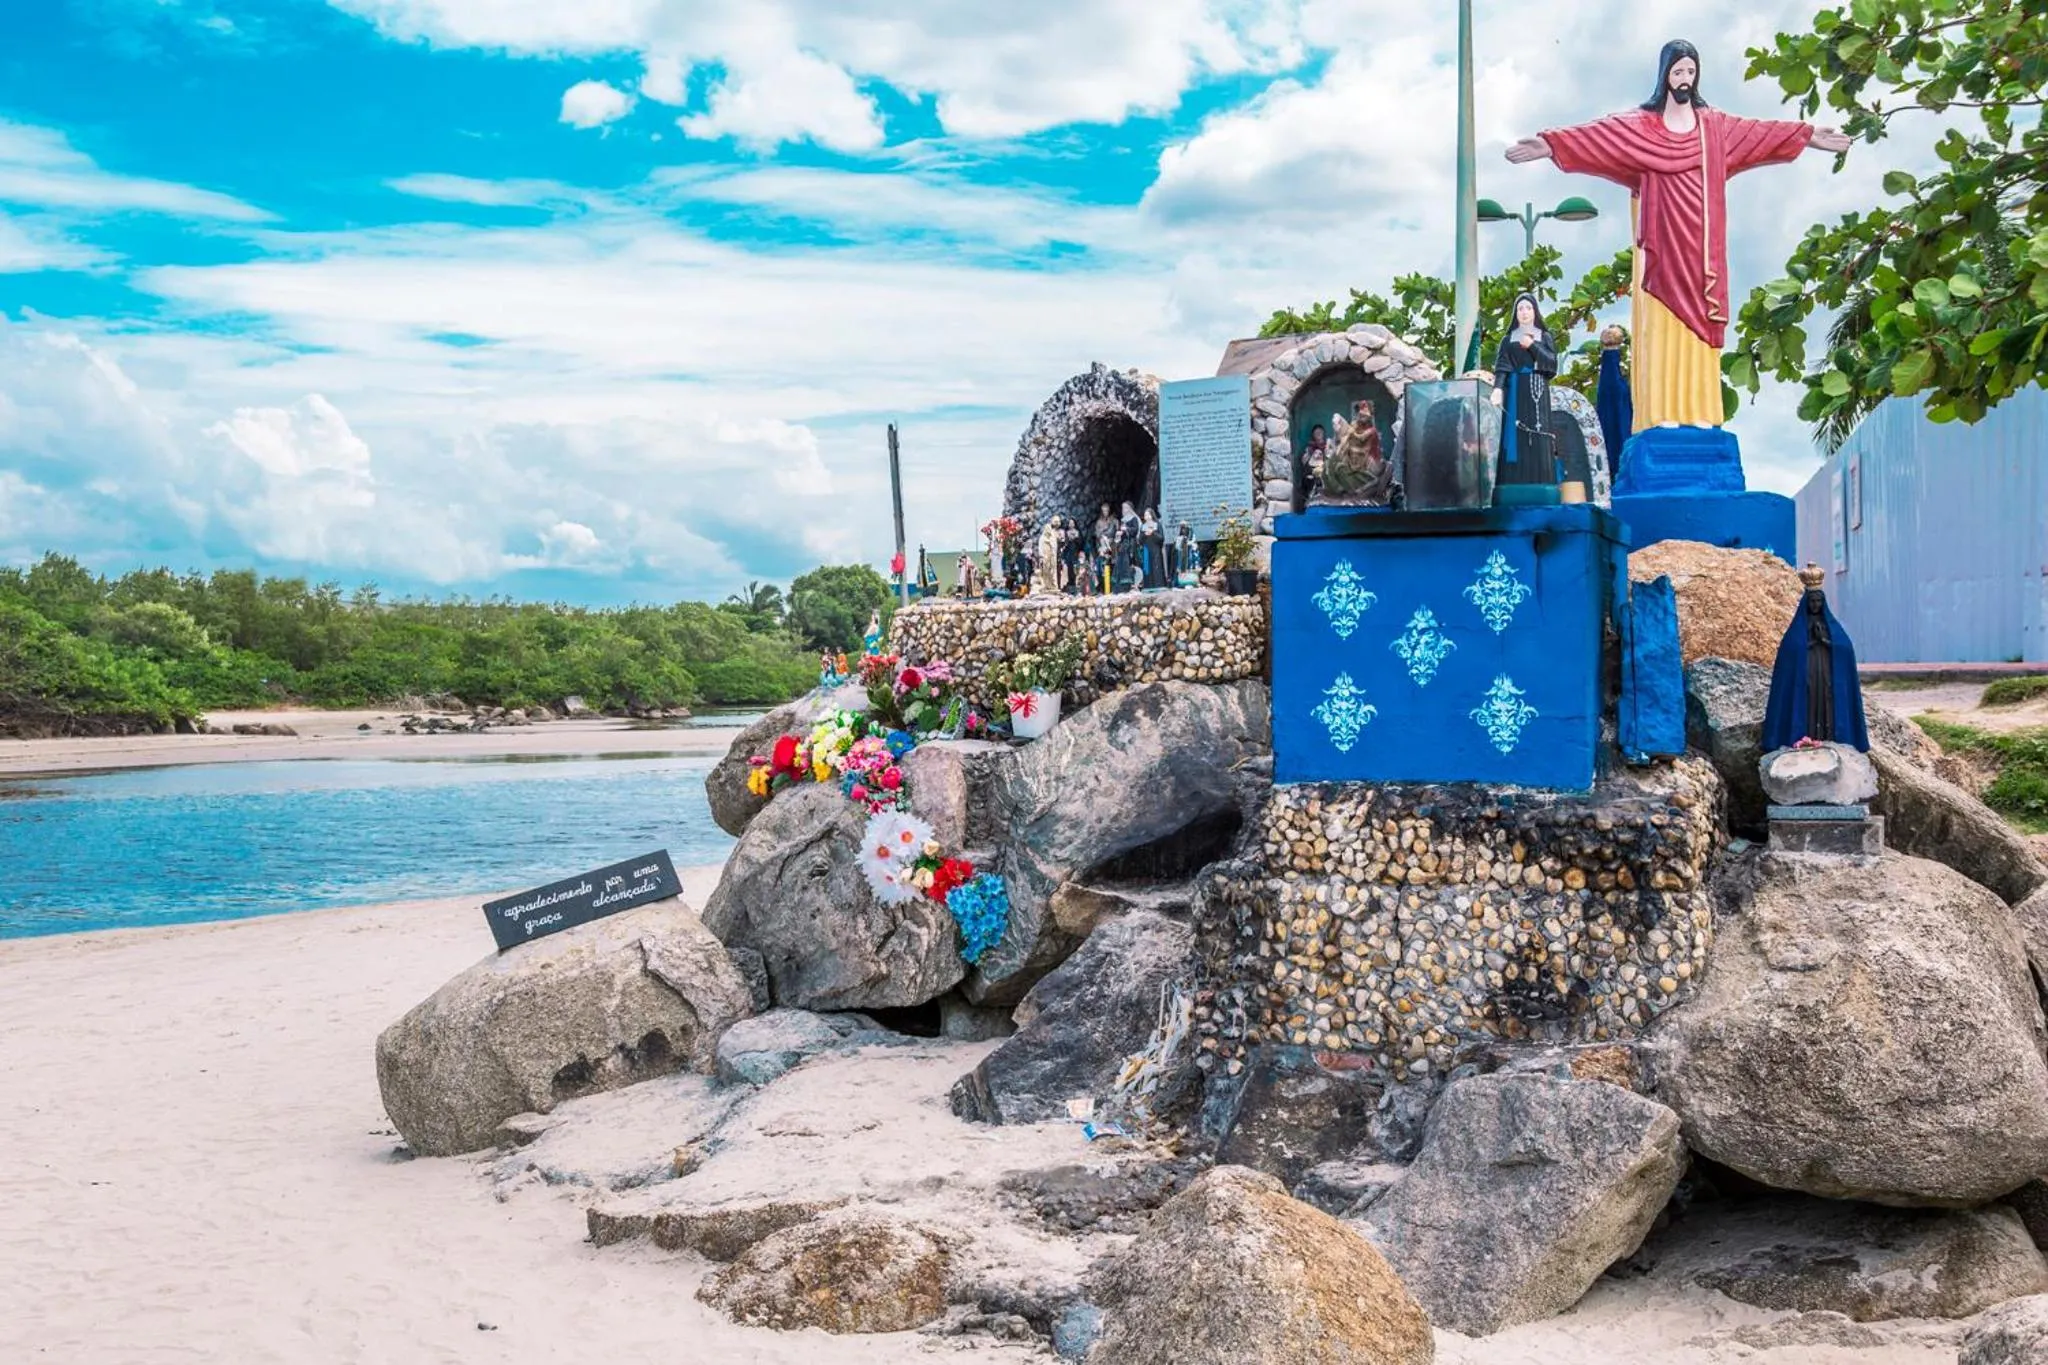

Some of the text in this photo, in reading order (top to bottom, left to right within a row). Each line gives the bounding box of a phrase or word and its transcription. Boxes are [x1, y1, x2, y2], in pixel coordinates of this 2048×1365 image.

[605, 874, 624, 890] por
[633, 863, 659, 878] uma
[524, 911, 563, 935] graça
